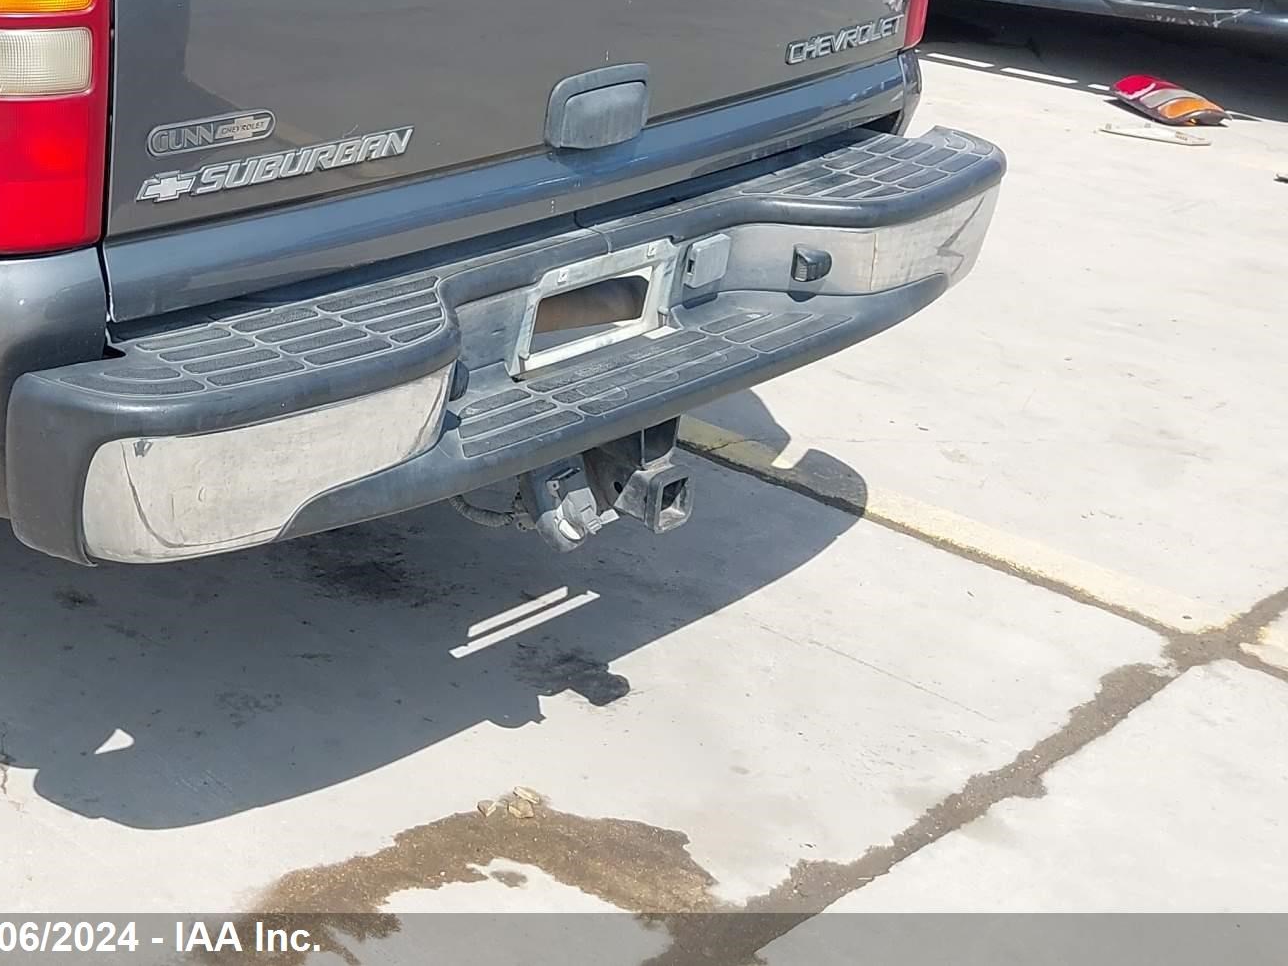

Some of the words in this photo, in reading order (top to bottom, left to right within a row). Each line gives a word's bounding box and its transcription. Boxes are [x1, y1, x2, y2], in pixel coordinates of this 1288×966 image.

[787, 14, 905, 64] CHEVROLET
[150, 122, 215, 152] GUNN
[195, 126, 415, 194] SUBURBAN
